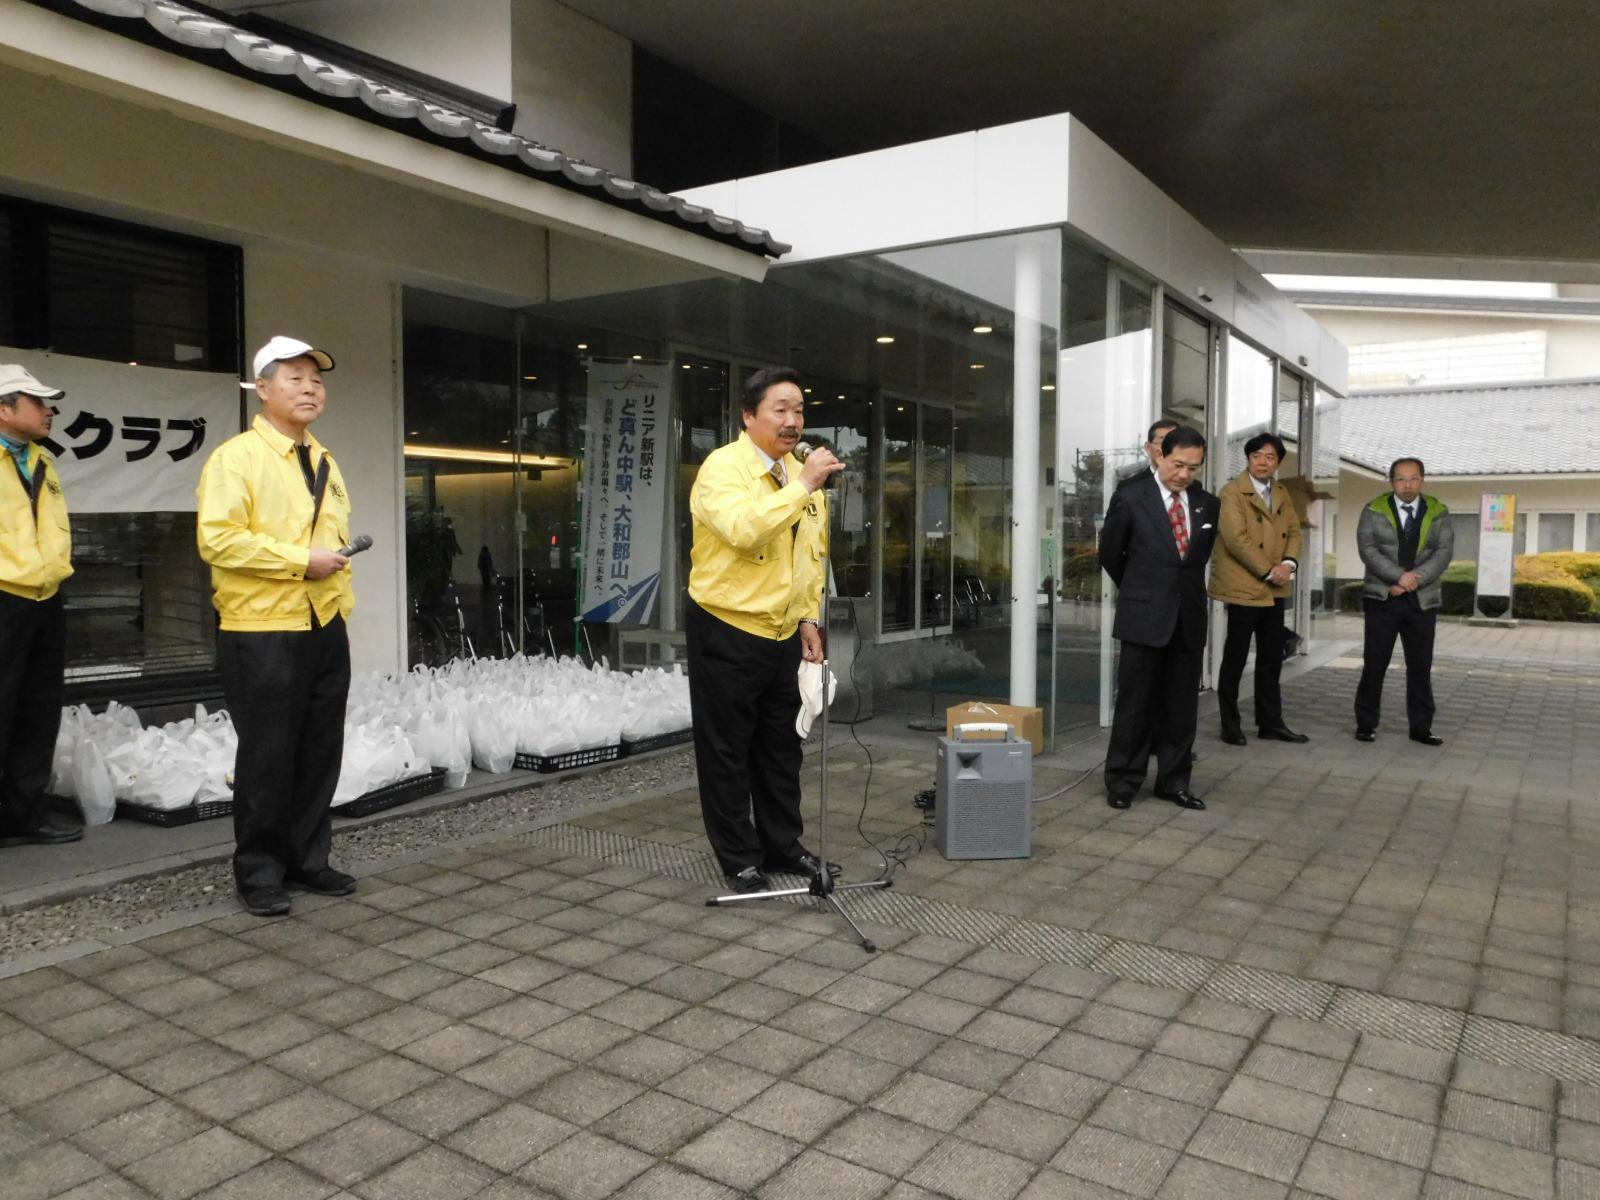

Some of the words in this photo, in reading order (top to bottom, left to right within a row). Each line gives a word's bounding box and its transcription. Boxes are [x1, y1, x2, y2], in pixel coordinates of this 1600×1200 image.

[610, 398, 637, 607] ど真ん中駅、大和郡山へ。
[640, 395, 655, 487] リニア新駅は、
